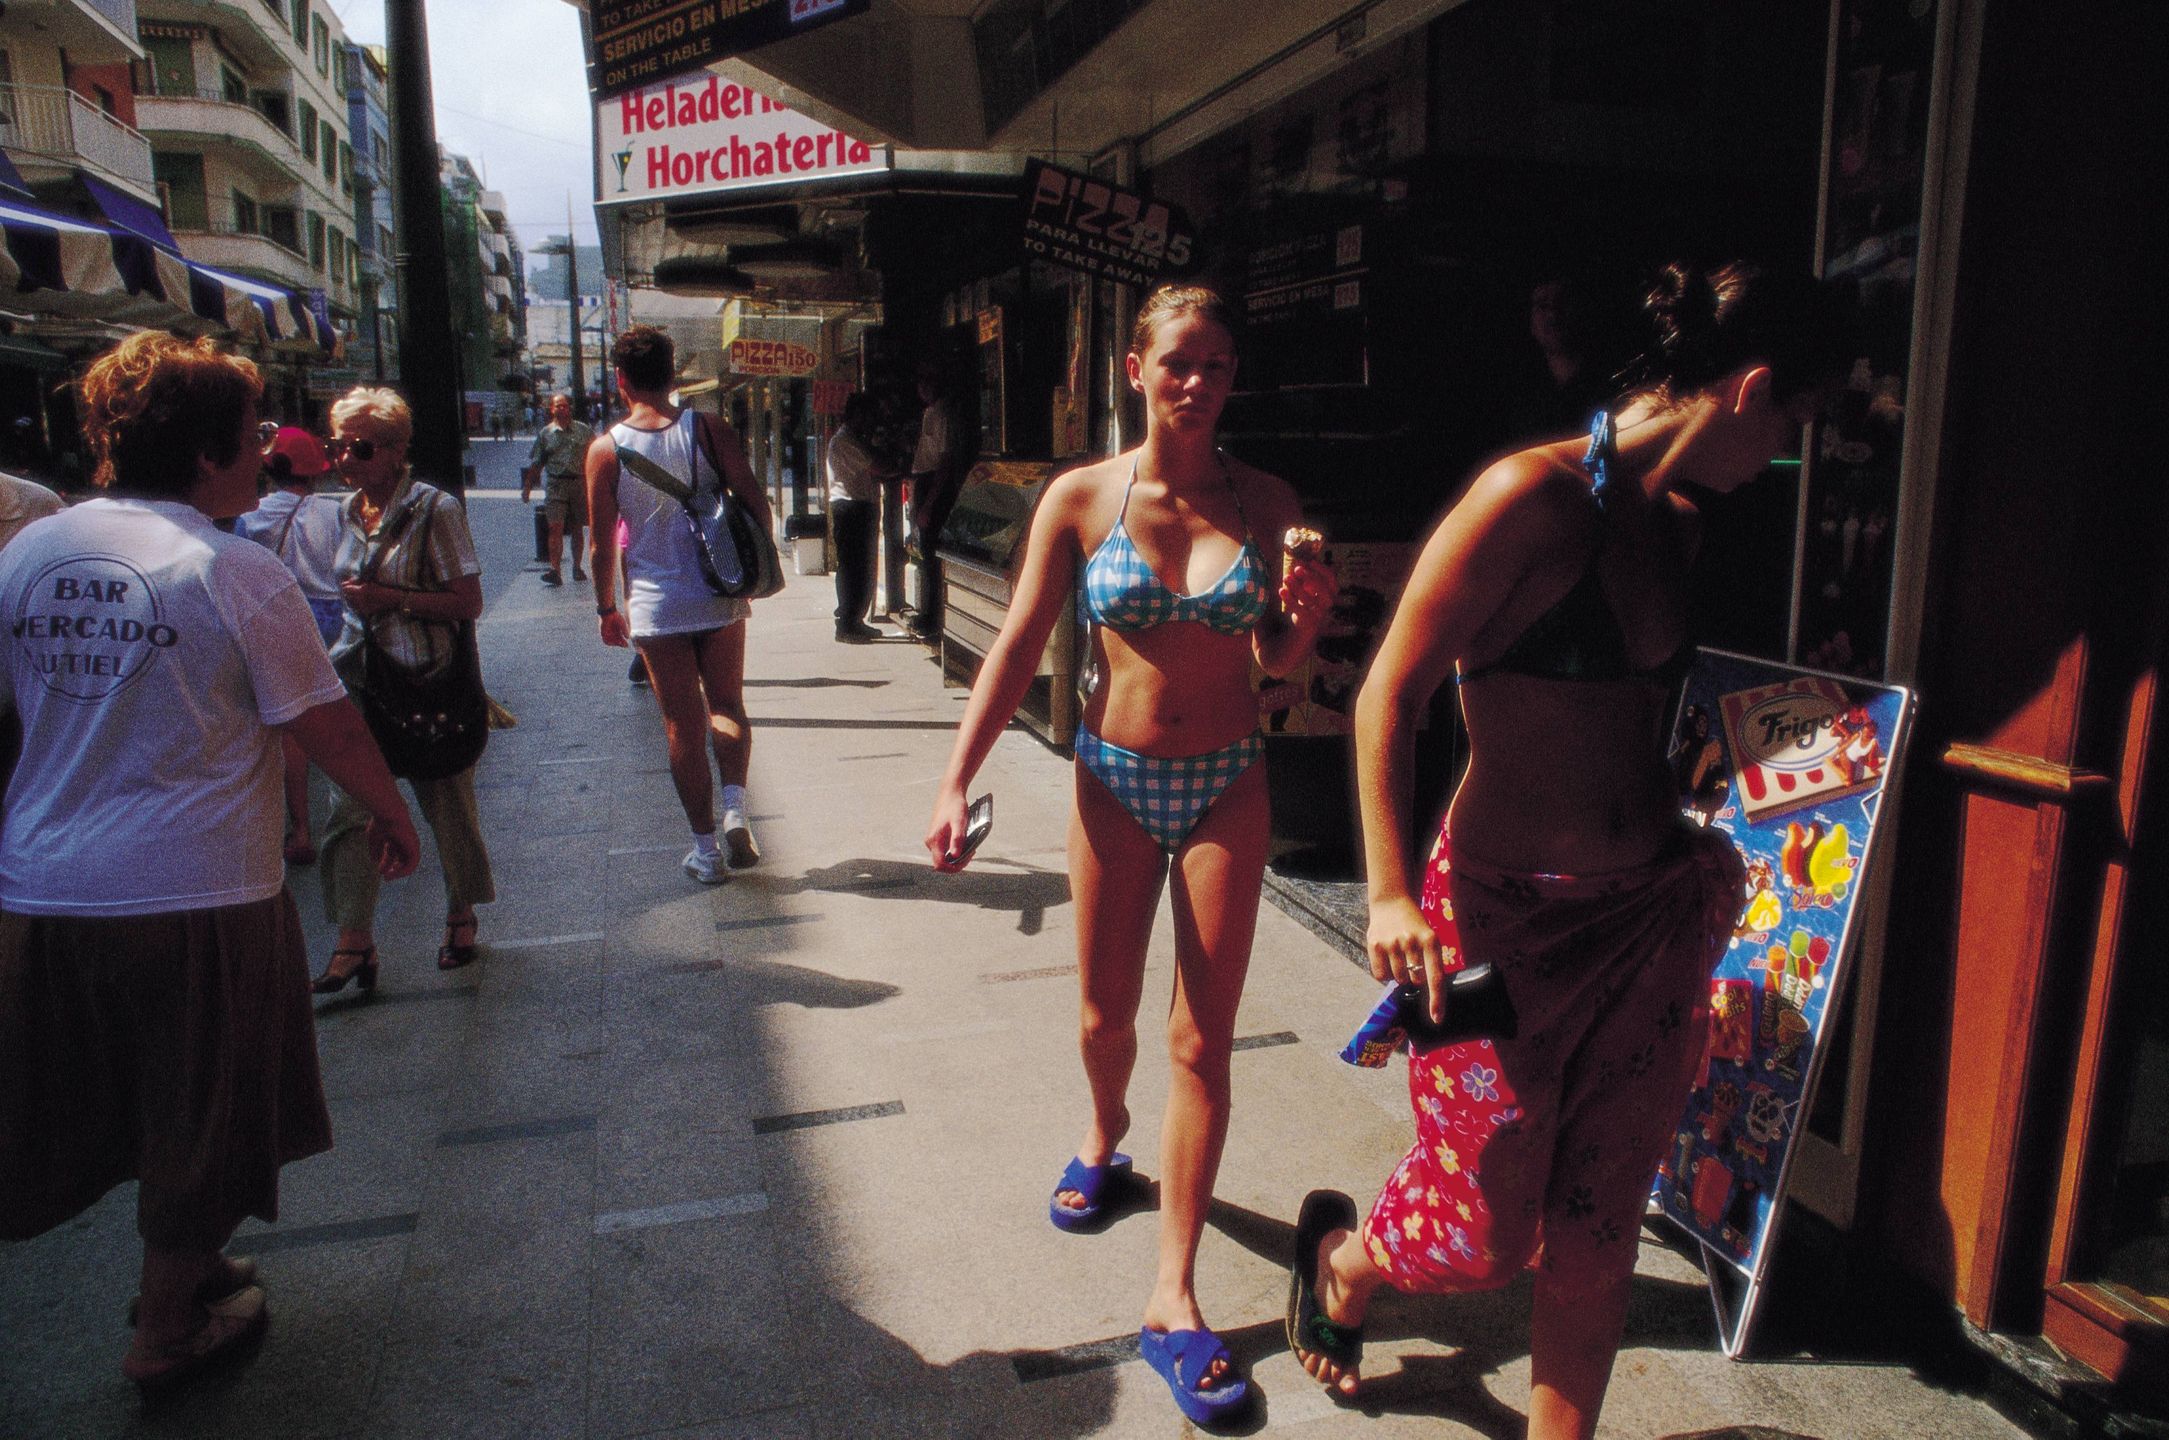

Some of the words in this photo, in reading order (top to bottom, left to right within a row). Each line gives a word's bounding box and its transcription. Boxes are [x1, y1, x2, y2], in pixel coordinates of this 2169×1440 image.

[603, 14, 686, 62] SERVICIO
[689, 4, 716, 35] EN
[605, 67, 628, 86] ON
[629, 55, 659, 76] THE
[662, 37, 712, 66] TABLE
[1031, 167, 1169, 245] PIZZA
[1023, 236, 1047, 255] TO
[1052, 246, 1099, 270] TAKE
[1025, 217, 1080, 247] PARA
[1087, 236, 1162, 270] LLEVAR
[731, 341, 787, 367] PIZZA
[788, 353, 817, 367] 150
[54, 577, 129, 604] BAR
[42, 653, 126, 678] UTIEL
[1759, 709, 1835, 750] Frigo
